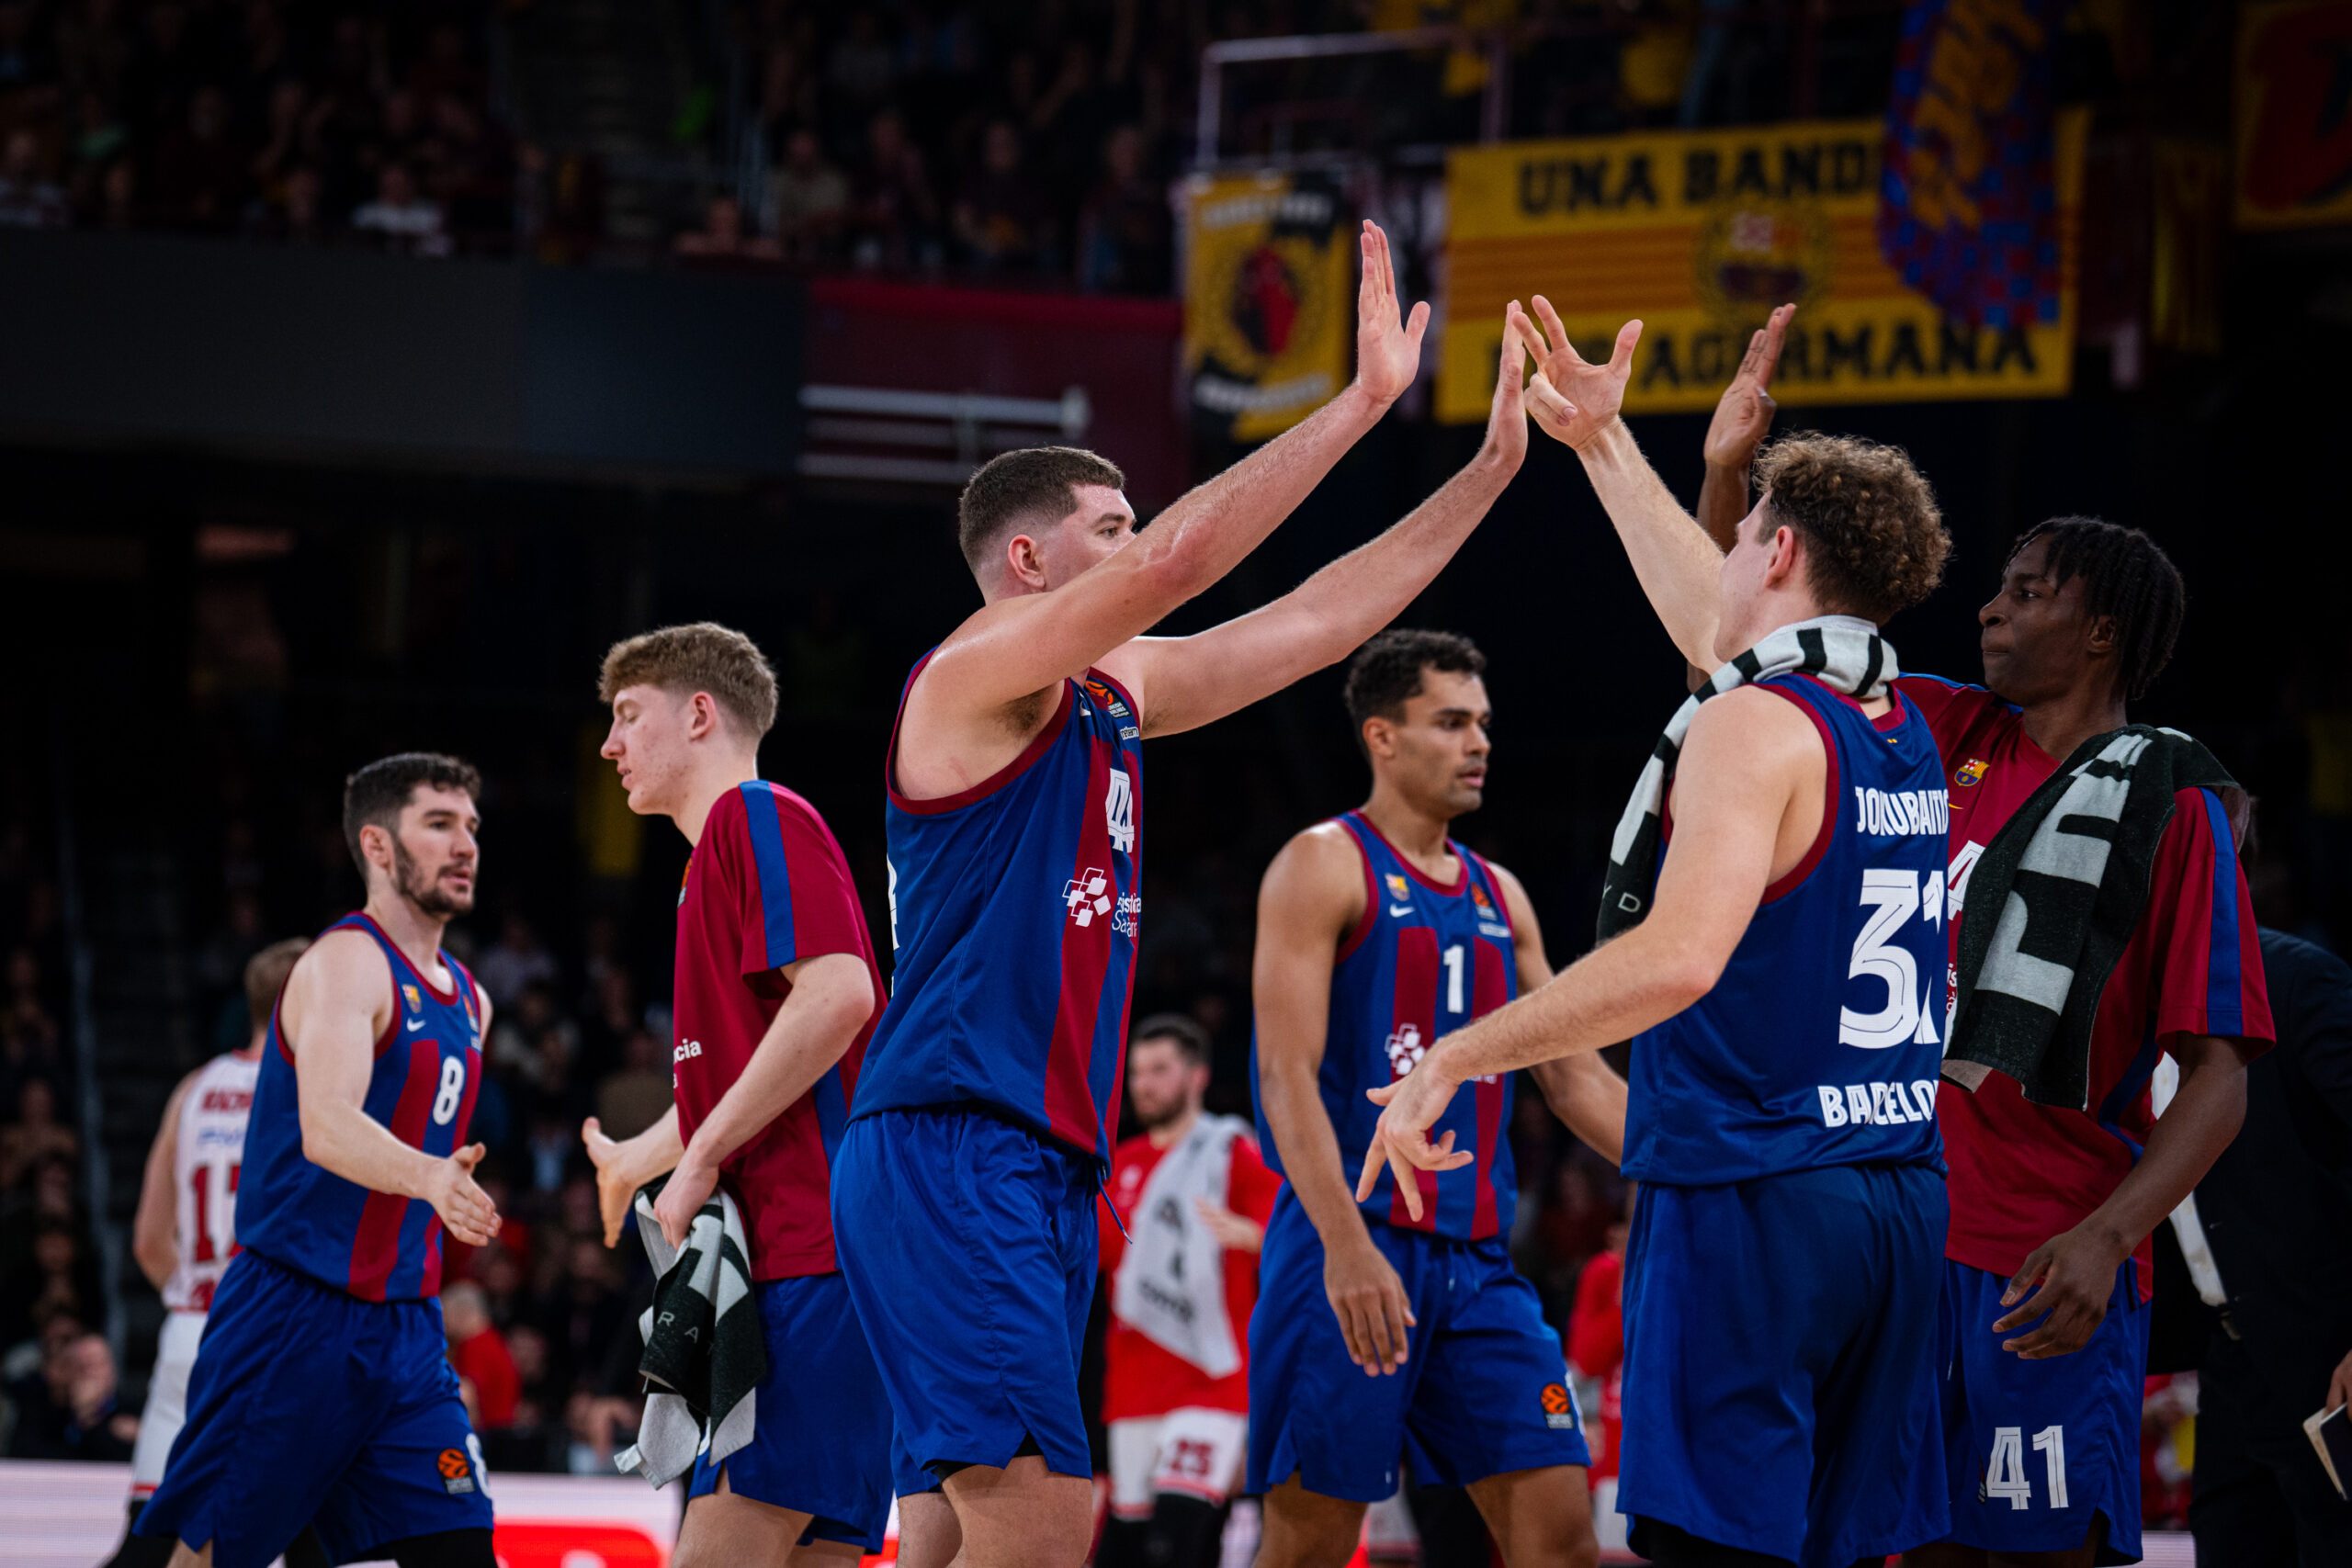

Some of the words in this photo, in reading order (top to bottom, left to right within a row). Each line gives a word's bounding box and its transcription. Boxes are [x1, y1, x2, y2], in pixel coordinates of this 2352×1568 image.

[1518, 154, 1657, 216] UNA
[1684, 141, 1871, 203] BAND
[1443, 945, 1464, 1013] 1
[1838, 869, 1944, 1049] 31
[673, 1038, 702, 1065] cia
[433, 1055, 464, 1125] 8
[1986, 1425, 2069, 1509] 41
